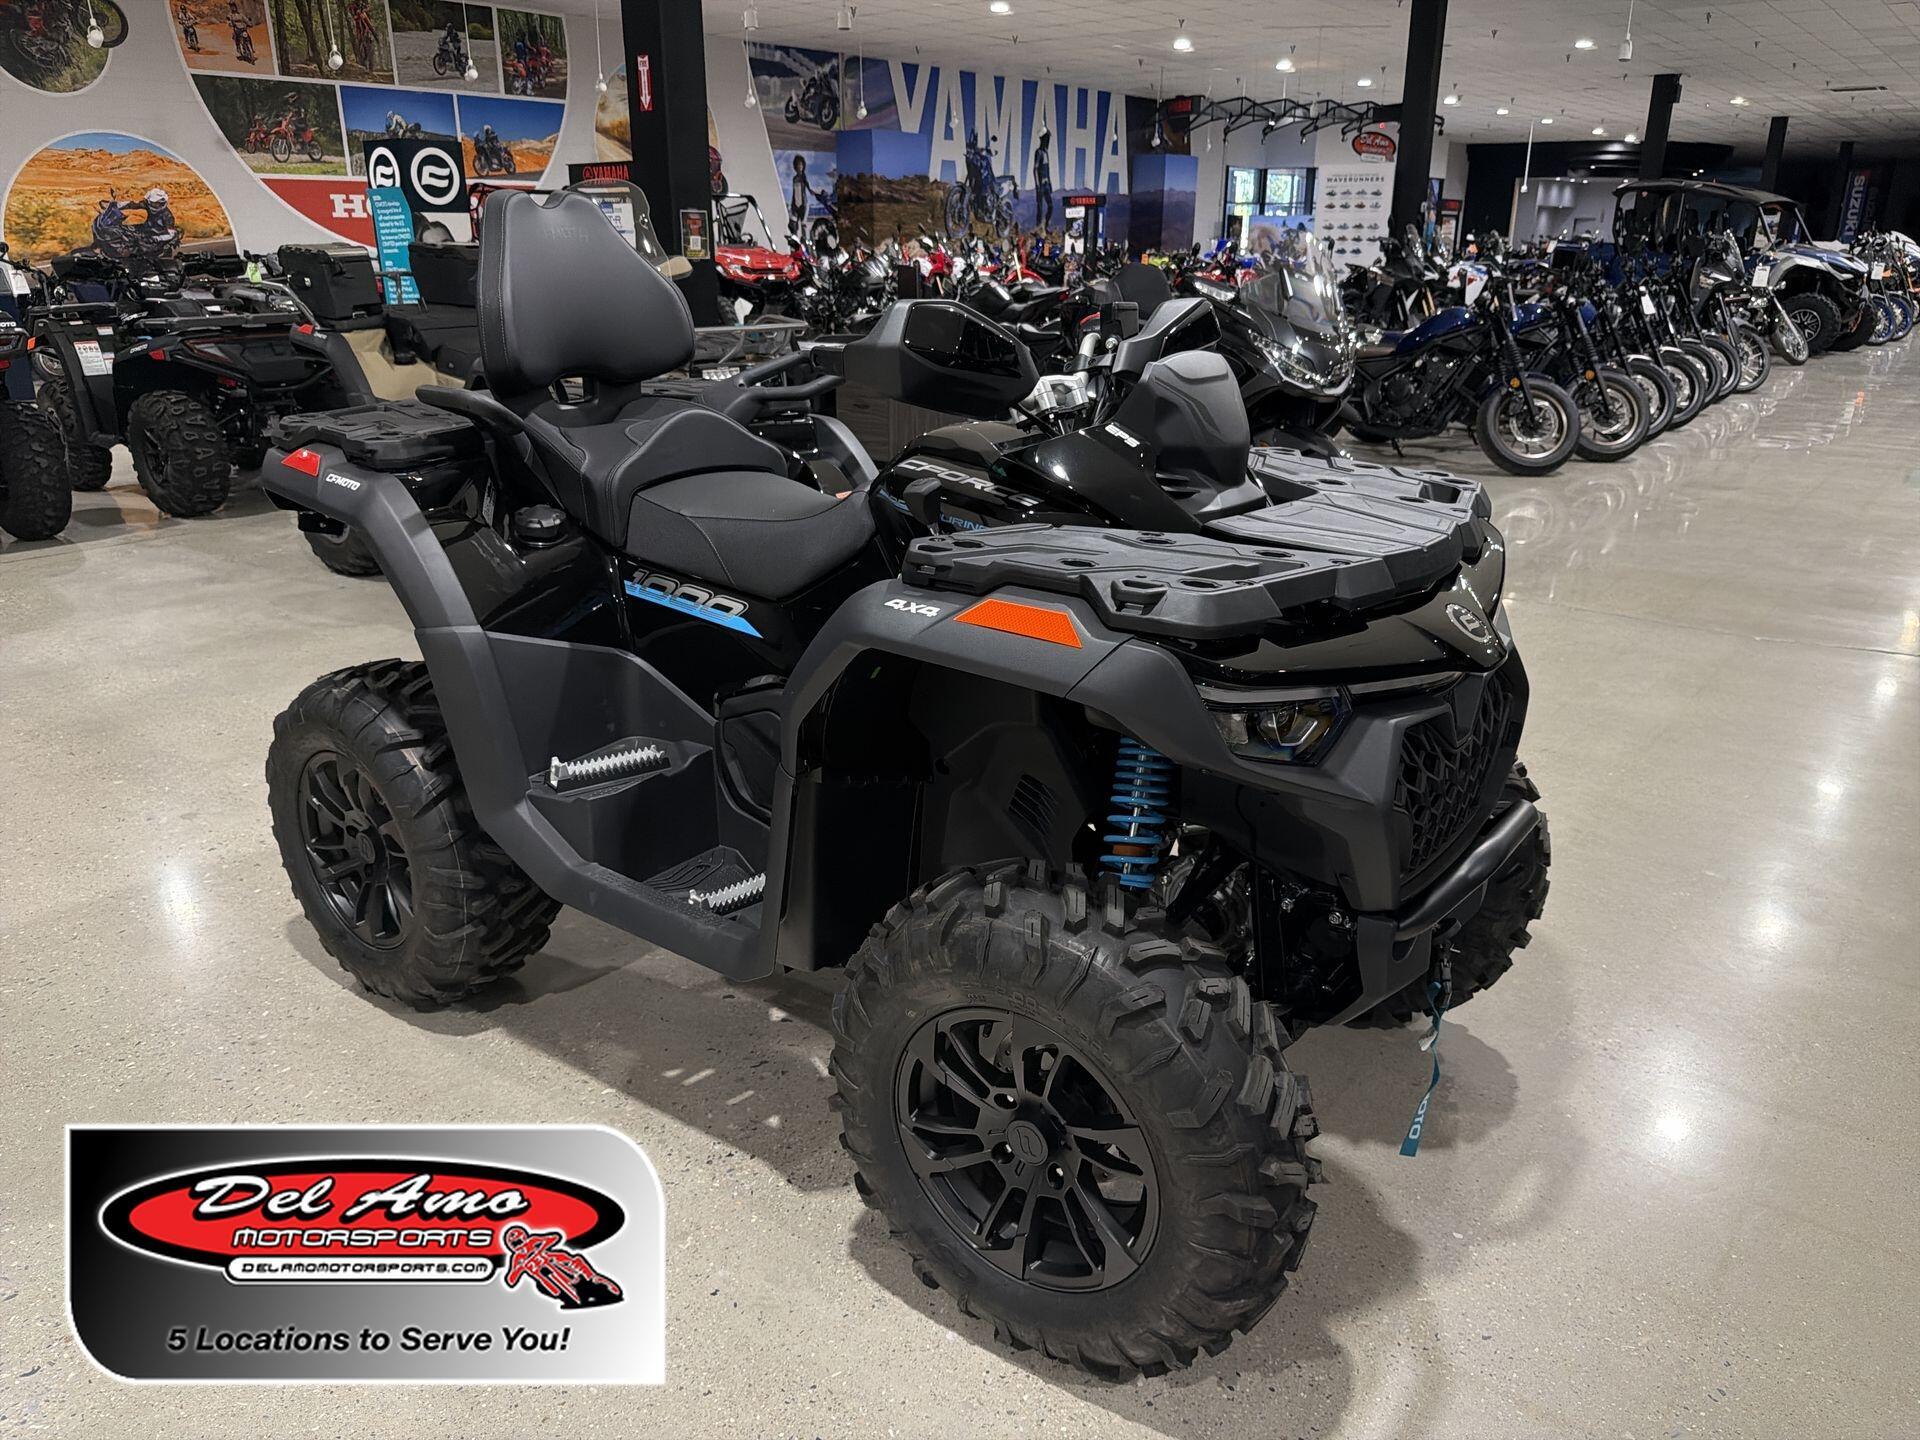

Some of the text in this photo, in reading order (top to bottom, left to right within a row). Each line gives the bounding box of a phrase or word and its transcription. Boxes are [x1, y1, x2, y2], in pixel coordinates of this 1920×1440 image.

[887, 59, 1130, 195] YAMAHA
[592, 164, 630, 181] YAMAHA
[1843, 176, 1866, 236] SUZUKI
[0, 321, 17, 332] OTO
[1104, 424, 1141, 448] EPS
[325, 473, 361, 491] CFMOTO
[896, 459, 1042, 507] CFORCE
[627, 568, 750, 621] 1000
